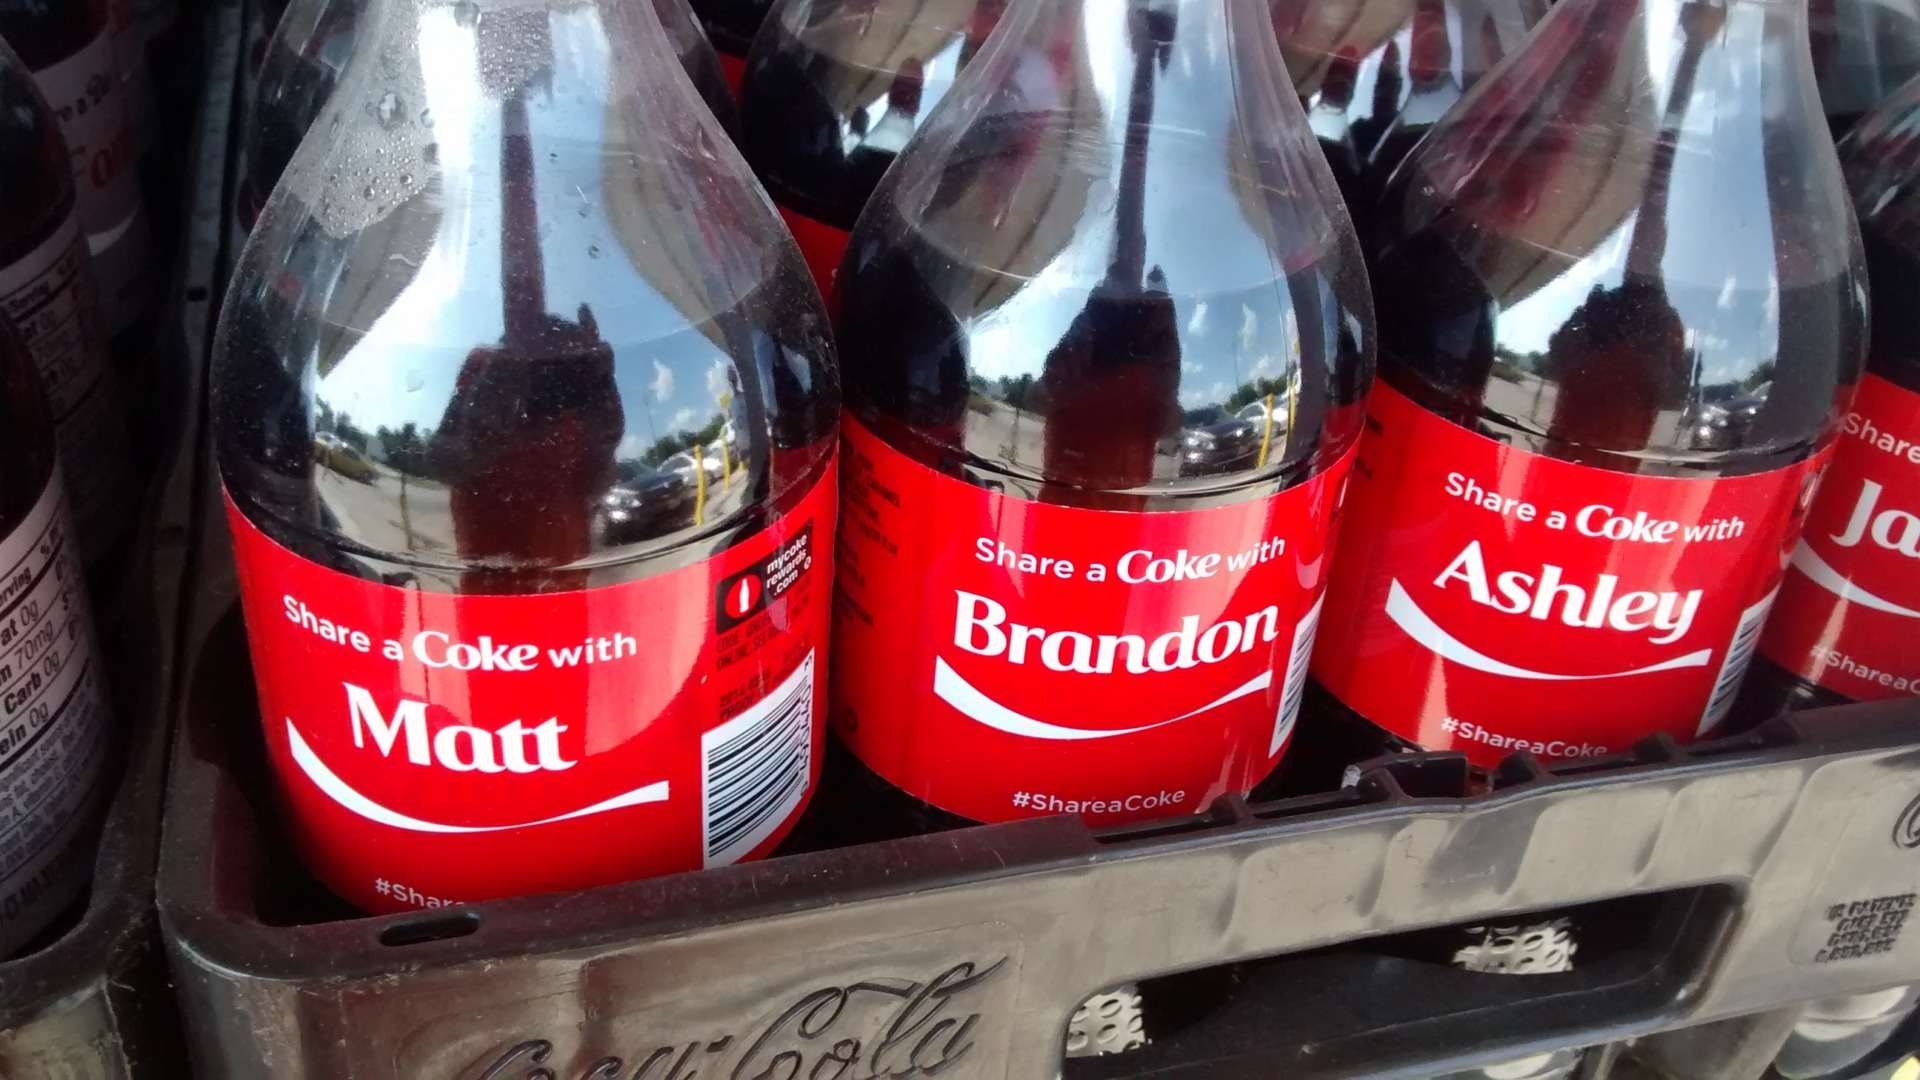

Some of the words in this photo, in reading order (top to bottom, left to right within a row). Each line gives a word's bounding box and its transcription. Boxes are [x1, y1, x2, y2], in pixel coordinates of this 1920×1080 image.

[1843, 412, 1920, 464] Share
[1444, 471, 1537, 523] Share
[1545, 509, 1567, 530] a
[1576, 503, 1680, 544] Coke
[1683, 515, 1746, 543] with
[1828, 477, 1920, 558] Ja
[765, 549, 808, 589] rewards
[766, 534, 808, 574] mycoke
[974, 536, 1075, 580] Share
[1085, 562, 1107, 583] a
[1116, 548, 1222, 584] Coke
[1225, 535, 1286, 573] with
[20, 600, 39, 627] 0g
[1432, 539, 1704, 645] Ashley
[13, 619, 54, 670] 70mg
[282, 594, 371, 654] Share
[382, 636, 405, 662] a
[412, 629, 539, 672] Coke
[547, 631, 637, 669] with
[953, 588, 1280, 675] Brandon
[4, 671, 42, 716] Carb
[43, 650, 60, 677] 0g
[29, 701, 49, 728] 0g
[341, 681, 579, 774] Matt
[1440, 715, 1608, 759] #ShareaCoke
[1012, 790, 1186, 814] #ShareaCoke
[374, 877, 465, 909] #Shar
